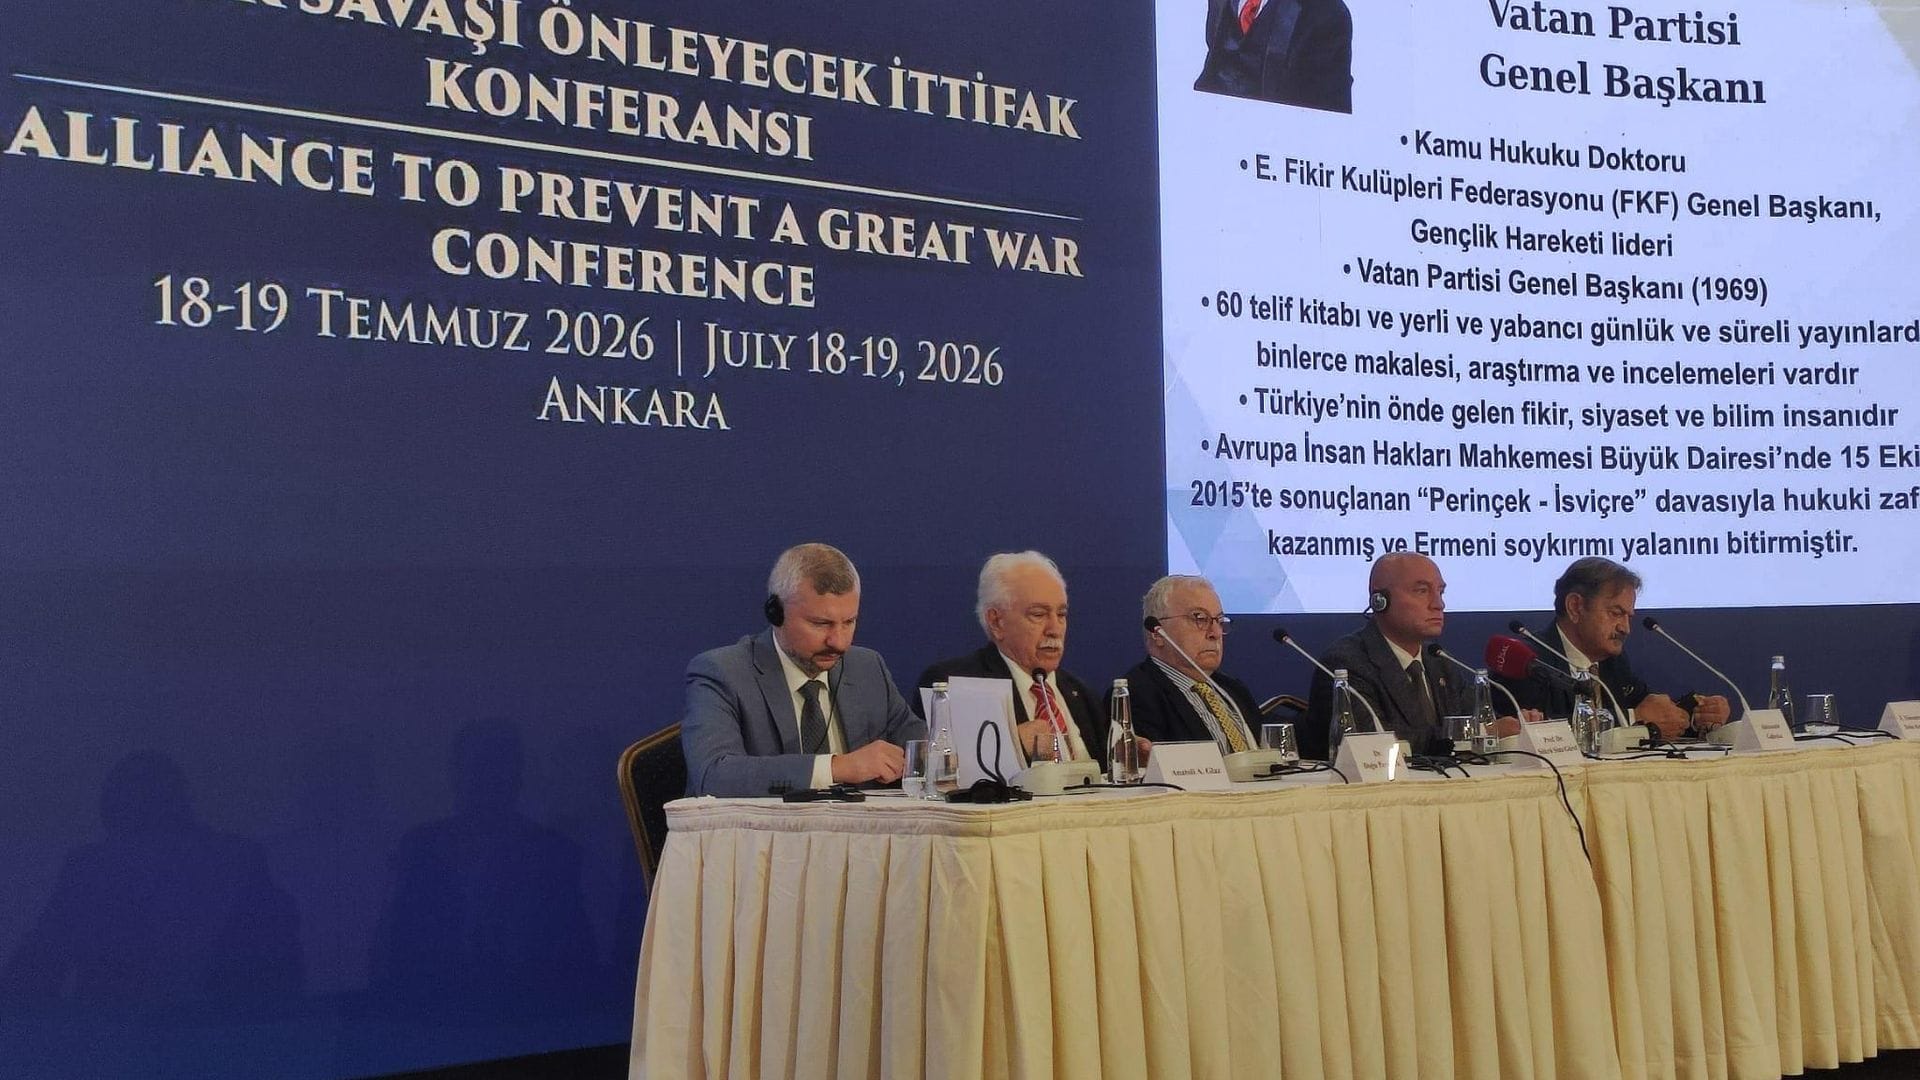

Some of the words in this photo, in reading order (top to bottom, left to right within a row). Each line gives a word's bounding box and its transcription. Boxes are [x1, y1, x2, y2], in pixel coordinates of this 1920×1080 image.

[1489, 0, 1595, 36] Vatan
[1608, 6, 1740, 45] Partisi
[300, 0, 523, 55] VAŞI
[540, 0, 880, 106] ÖNLEYECEK
[889, 56, 1081, 139] İTTİFAK
[1480, 54, 1591, 95] Genel
[1603, 64, 1766, 107] Başkanı
[426, 58, 813, 160] KONFERANSI
[1416, 130, 1481, 159] Kamu
[1490, 137, 1579, 167] Hukuku
[1589, 145, 1685, 172] Doktoru
[4, 106, 374, 195] ALLIANCE
[392, 153, 479, 206] TO
[499, 167, 759, 239] PREVENT
[770, 203, 808, 245] A
[819, 209, 974, 264] GREAT
[984, 229, 1083, 277] WAR
[1256, 154, 1276, 181] E.
[1286, 158, 1334, 188] Fikir
[1342, 165, 1442, 202] Kulüpleri
[1451, 178, 1603, 215] Federasyonu
[1612, 189, 1678, 221] (FKF)
[1688, 192, 1759, 217] Genel
[1769, 195, 1880, 223] Başkanı,
[1412, 219, 1498, 252] Gençlik
[1506, 226, 1603, 254] Hareketi
[1612, 232, 1672, 256] lideri
[432, 229, 815, 307] CONFERENCE
[1357, 257, 1418, 287] Vatan
[1428, 264, 1500, 292] Partisi
[1509, 270, 1577, 297] Genel
[1586, 273, 1683, 304] Başkanı
[1692, 277, 1767, 307] (1969)
[155, 275, 287, 333] 18-19
[307, 288, 529, 351] TEMMUZ
[545, 309, 653, 360] 2026
[704, 323, 797, 377] JULY
[808, 332, 904, 386] 18-19,
[918, 341, 1003, 385] 2026
[1217, 291, 1242, 317] 60
[1250, 295, 1293, 321] telif
[1300, 298, 1360, 327] kitabı
[1368, 310, 1393, 329] ve
[1400, 309, 1448, 337] yerli
[1456, 316, 1482, 335] ve
[1490, 314, 1582, 342] yabancı
[1591, 317, 1674, 346] günlük
[1682, 325, 1710, 342] ve
[1719, 320, 1789, 343] süreli
[1798, 320, 1920, 349] yayınlard
[1257, 341, 1347, 371] binlerce
[1355, 351, 1460, 382] makalesi,
[1469, 358, 1579, 387] araştırma
[1587, 365, 1614, 383] ve
[1623, 360, 1774, 385] incelemeleri
[1783, 362, 1859, 384] vardır
[537, 376, 730, 429] ANKARA
[1254, 388, 1380, 423] Türkiye’nin
[1388, 395, 1444, 422] önde
[1452, 399, 1514, 429] gelen
[1521, 401, 1573, 430] fikir,
[1582, 403, 1669, 432] siyaset
[1675, 410, 1704, 427] ve
[1713, 404, 1774, 427] bilim
[1784, 404, 1898, 427] insanıdır
[1215, 433, 1297, 467] Avrupa
[1305, 431, 1365, 464] İnsan
[1374, 440, 1451, 467] Hakları
[1460, 443, 1592, 469] Mahkemesi
[1601, 446, 1679, 476] Büyük
[1688, 446, 1831, 469] Dairesi’nde
[1841, 446, 1869, 468] 15
[1880, 445, 1920, 467] Eki
[1191, 480, 1272, 508] 2015’te
[1280, 485, 1410, 516] sonuçlanan
[1418, 487, 1531, 518] “Perinçek
[1555, 484, 1645, 519] İsviçre”
[1656, 488, 1775, 518] davasıyla
[1784, 487, 1870, 511] hukuki
[1880, 486, 1920, 509] zaf
[1269, 529, 1374, 562] kazanmış
[1382, 538, 1407, 552] ve
[1415, 532, 1495, 556] Ermeni
[1505, 532, 1613, 562] soykırımı
[1621, 532, 1718, 562] yalanını
[1728, 530, 1857, 558] bitirmiştir.
